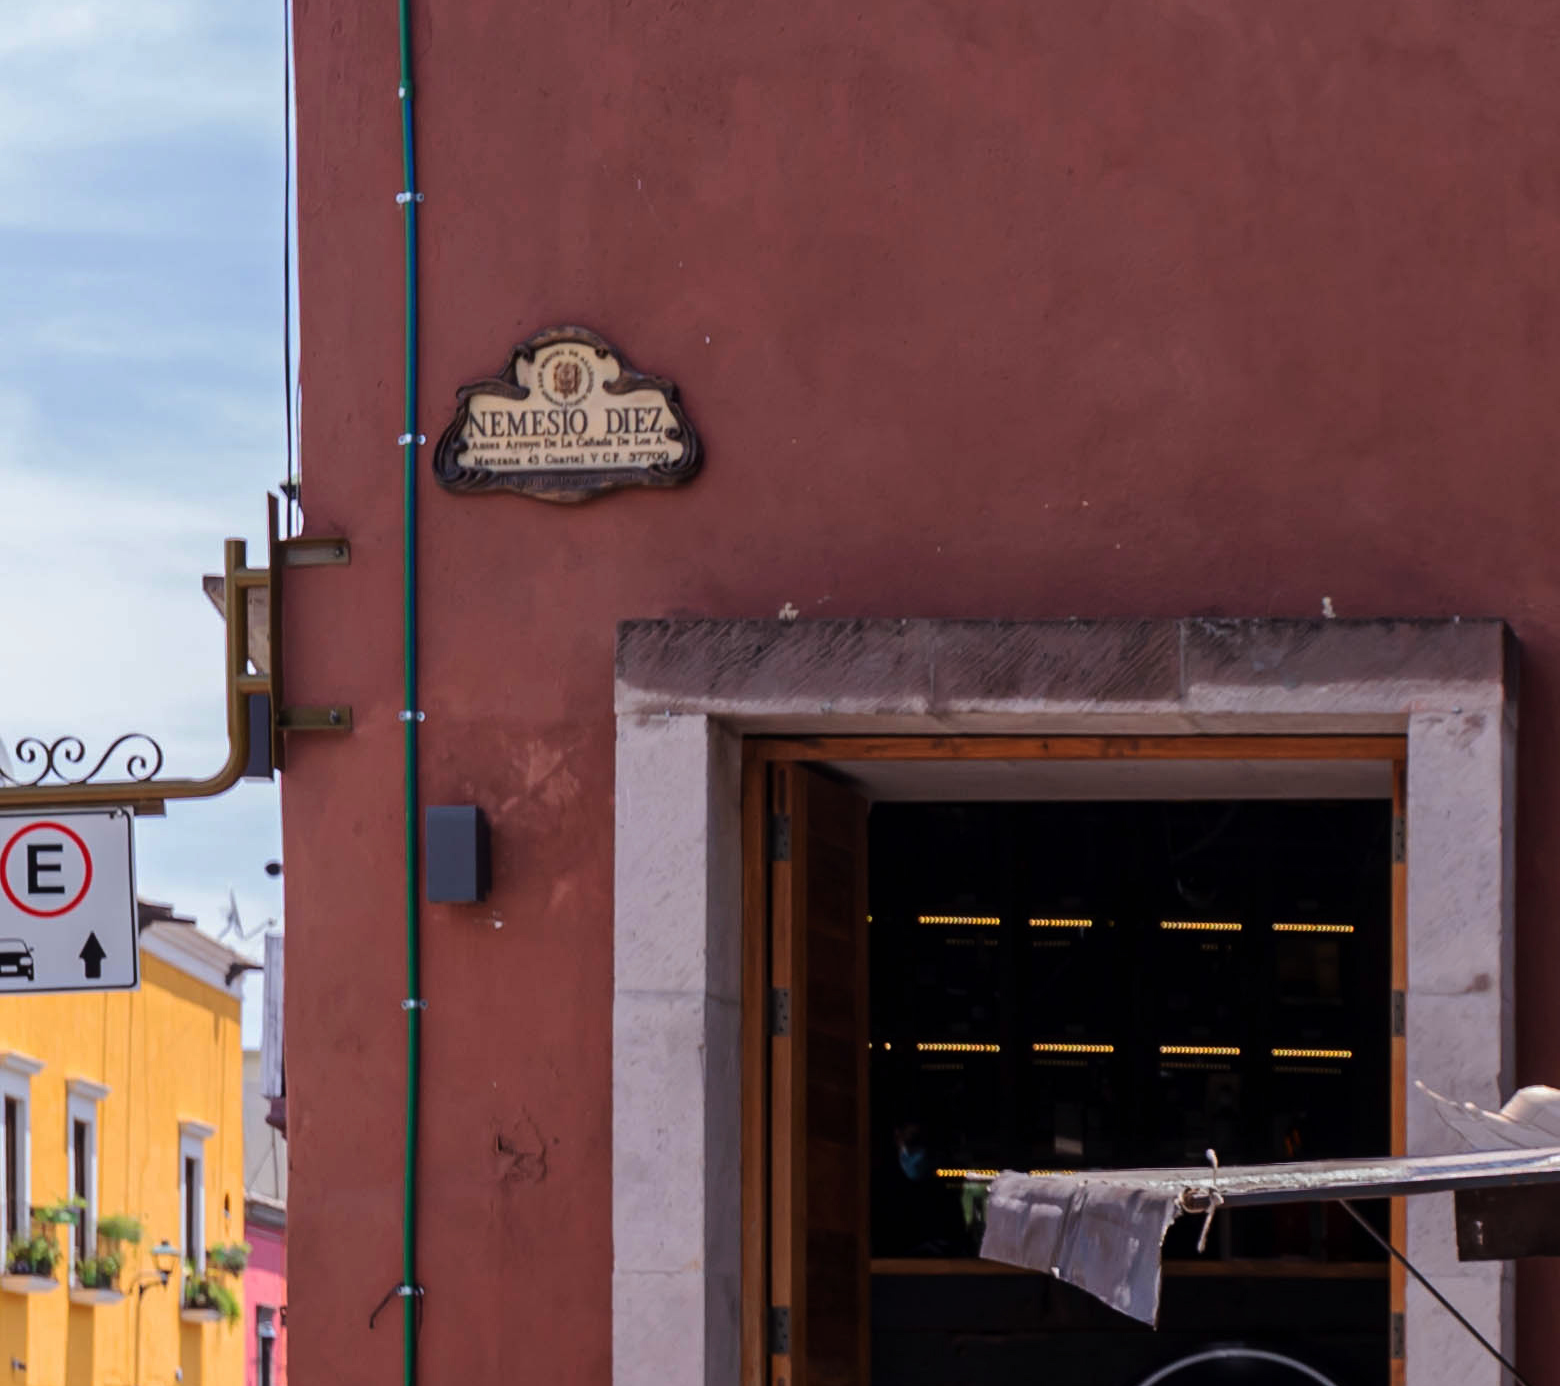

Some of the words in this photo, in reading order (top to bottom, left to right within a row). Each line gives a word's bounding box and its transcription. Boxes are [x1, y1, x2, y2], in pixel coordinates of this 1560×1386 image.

[468, 409, 588, 438] NEMESIO
[605, 407, 664, 434] DIEZ
[544, 438, 556, 448] De
[561, 437, 572, 448] La
[617, 436, 629, 446] De
[635, 436, 651, 446] Los
[474, 455, 520, 466] Manzana
[545, 453, 584, 464] Cuartel
[591, 453, 598, 463] V
[27, 844, 65, 894] E
